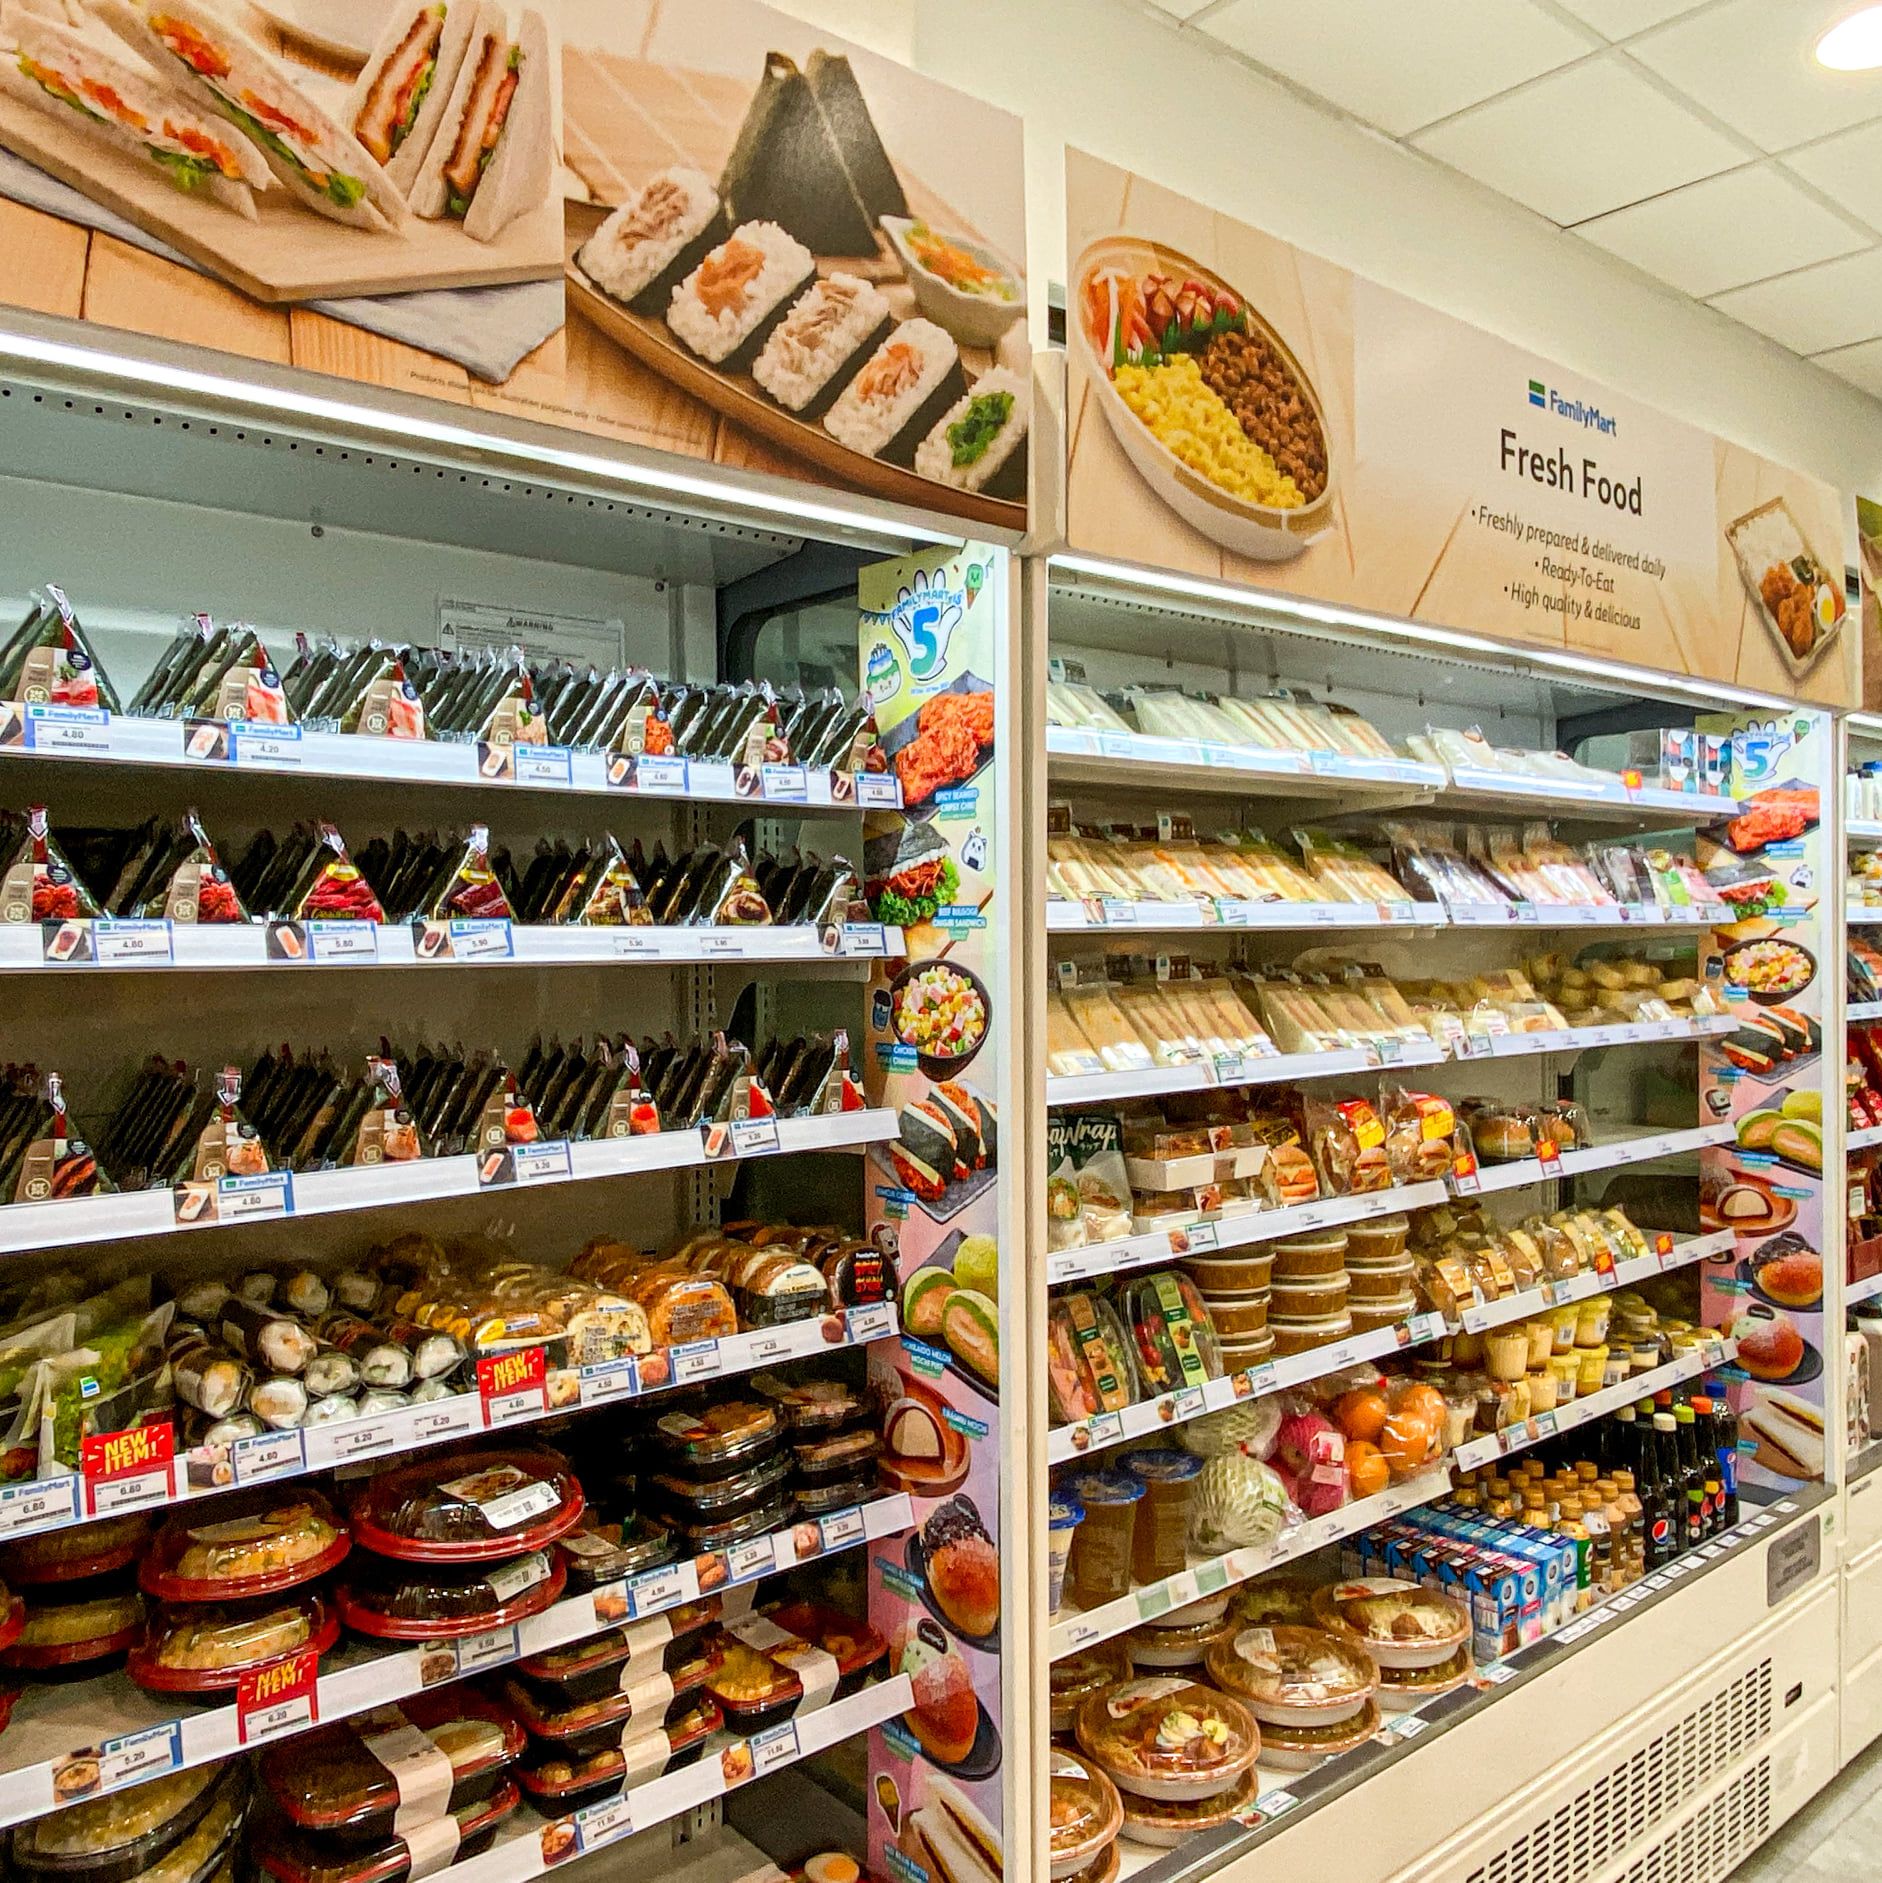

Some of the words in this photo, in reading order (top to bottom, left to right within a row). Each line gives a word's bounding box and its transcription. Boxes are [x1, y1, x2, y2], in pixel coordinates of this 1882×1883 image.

[1550, 390, 1617, 437] FamilyMart
[1500, 428, 1574, 493] Fresh
[1582, 458, 1642, 516] Food
[1479, 505, 1525, 541] Freshly
[1526, 525, 1579, 555] prepared
[1581, 536, 1590, 556] &
[1592, 543, 1640, 572] delivered
[1641, 556, 1667, 581] daily
[1542, 556, 1615, 593] Ready-To-Eat
[1511, 582, 1540, 610] High
[1542, 595, 1582, 621] quality
[1584, 603, 1593, 620] &
[1595, 605, 1641, 631] delicious
[910, 606, 940, 676] 5
[1743, 741, 1769, 778] 5
[114, 923, 163, 932] FamilyMart
[238, 1176, 285, 1187] FamilyMart
[493, 1352, 527, 1376] NEW
[494, 1363, 534, 1392] ITEM!
[104, 1429, 149, 1455] NEW
[105, 1441, 157, 1475] ITEM!
[18, 1480, 70, 1497] FamilyMart
[255, 1669, 304, 1702] ITEM!
[257, 1661, 297, 1685] NEW
[123, 1727, 173, 1749] FamilyMart
